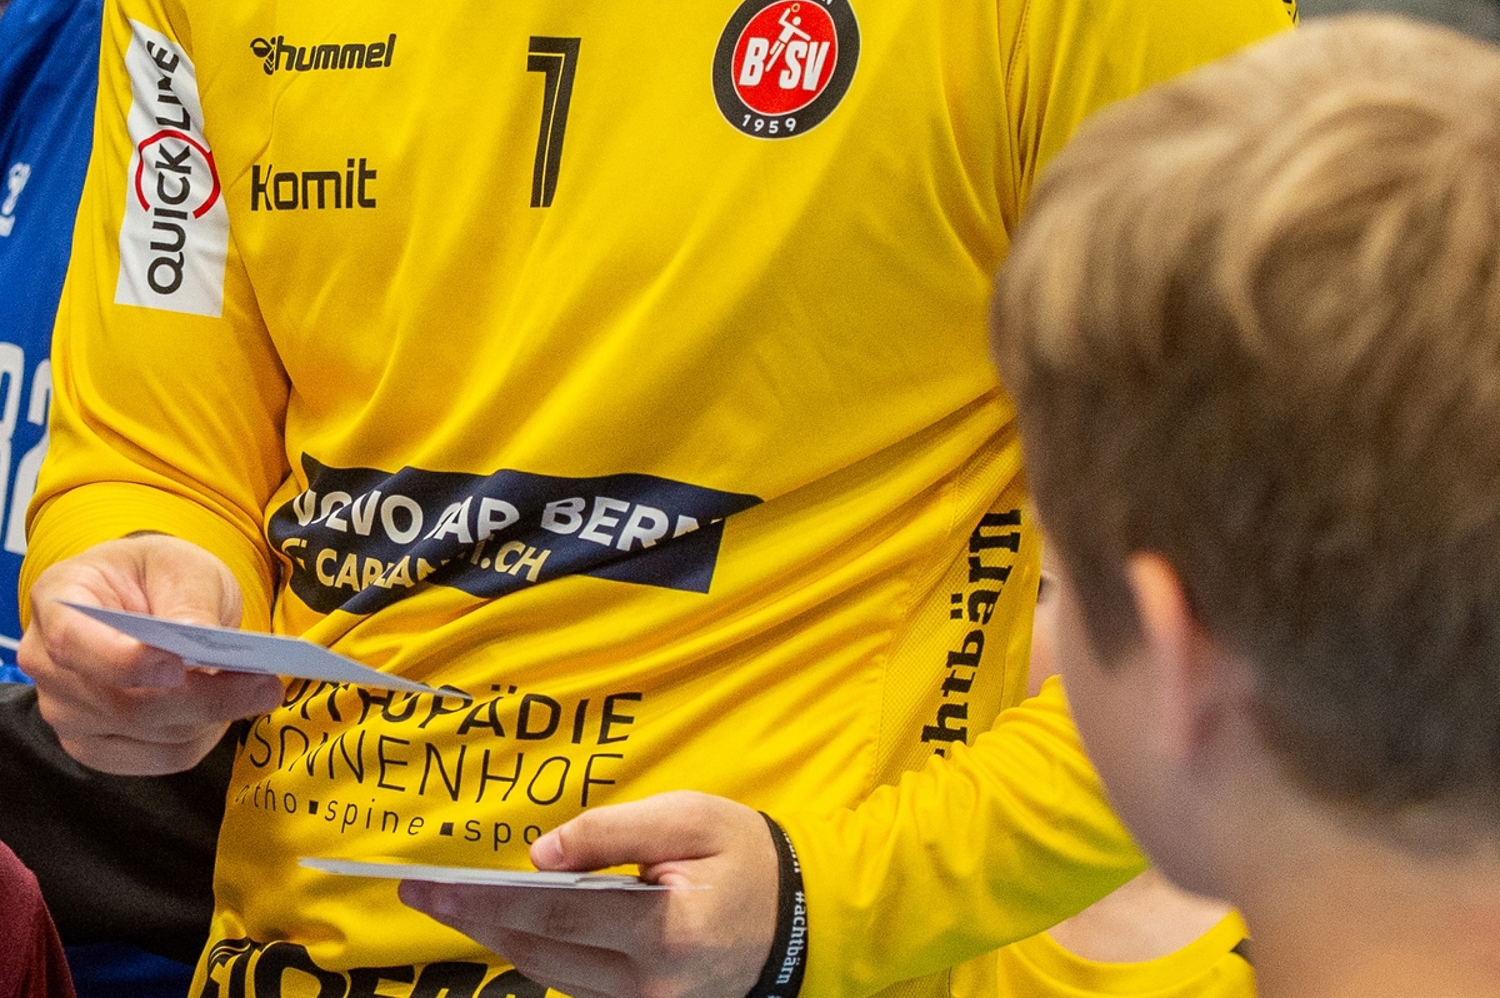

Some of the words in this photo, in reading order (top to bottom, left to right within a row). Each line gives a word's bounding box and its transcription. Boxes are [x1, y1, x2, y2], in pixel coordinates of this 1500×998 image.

[274, 33, 397, 72] hummel
[739, 36, 831, 91] BSV
[742, 114, 797, 134] 1959
[324, 798, 425, 836] spine
[776, 891, 808, 984] #achtbärn
